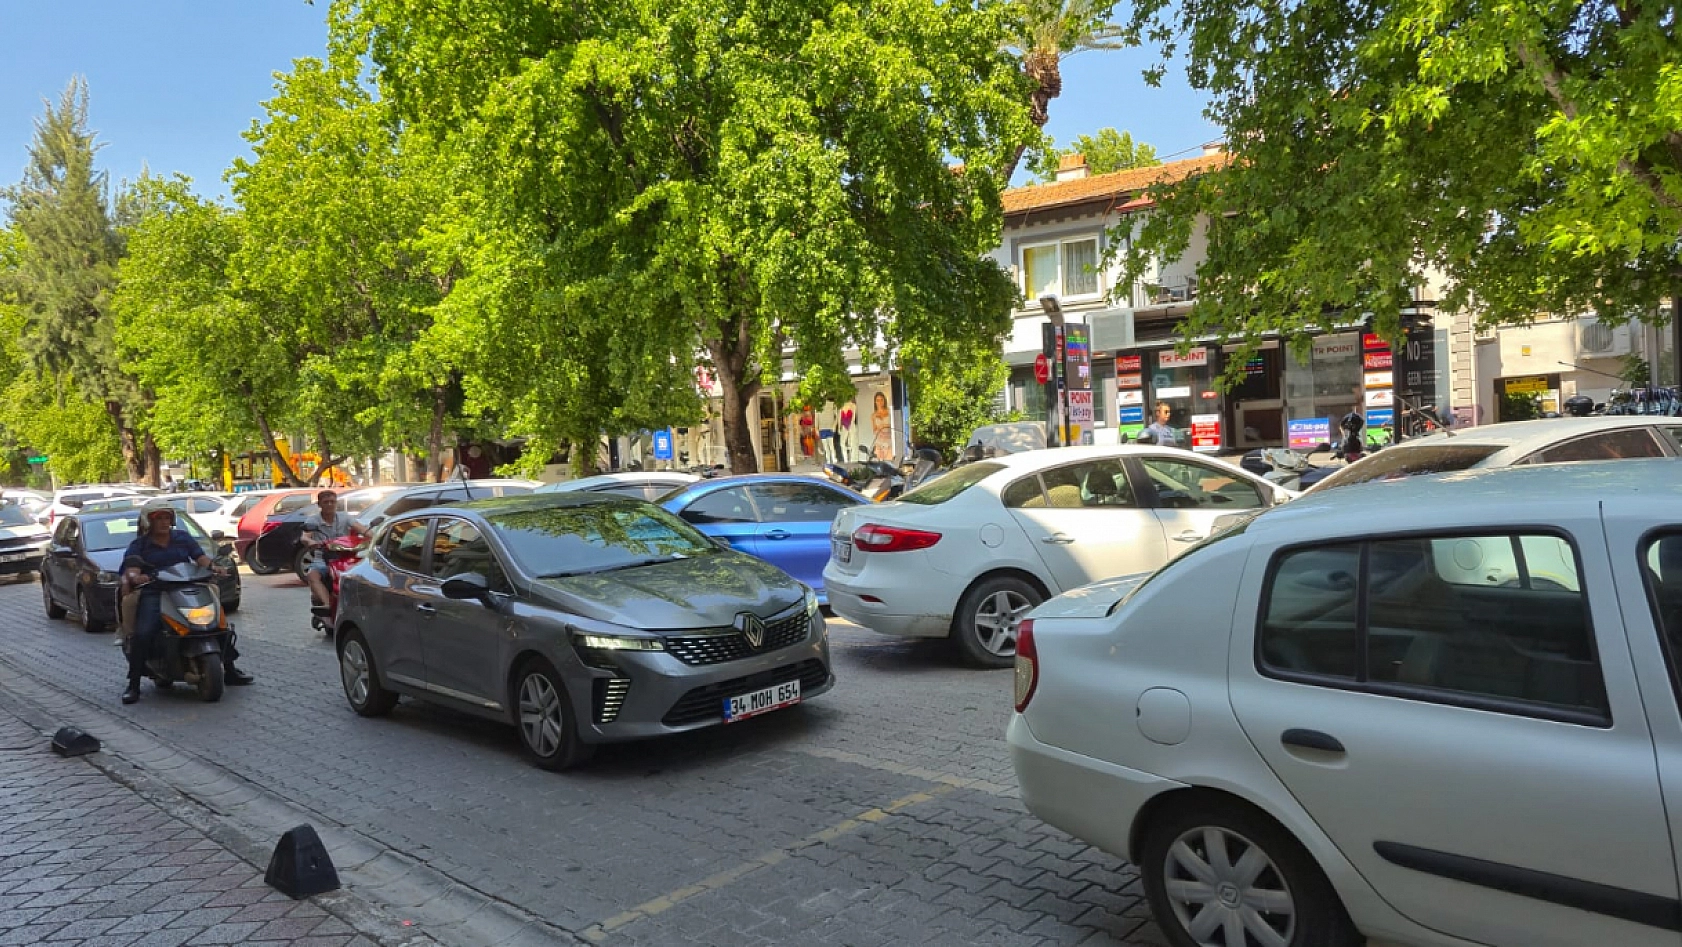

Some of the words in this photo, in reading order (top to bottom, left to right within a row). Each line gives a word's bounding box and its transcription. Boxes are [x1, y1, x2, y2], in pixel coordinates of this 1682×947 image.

[1326, 344, 1354, 354] POINT
[1406, 340, 1421, 361] NO
[1071, 391, 1092, 404] POINT
[731, 698, 747, 715] 34
[751, 689, 773, 710] MOH
[778, 682, 798, 702] 654
